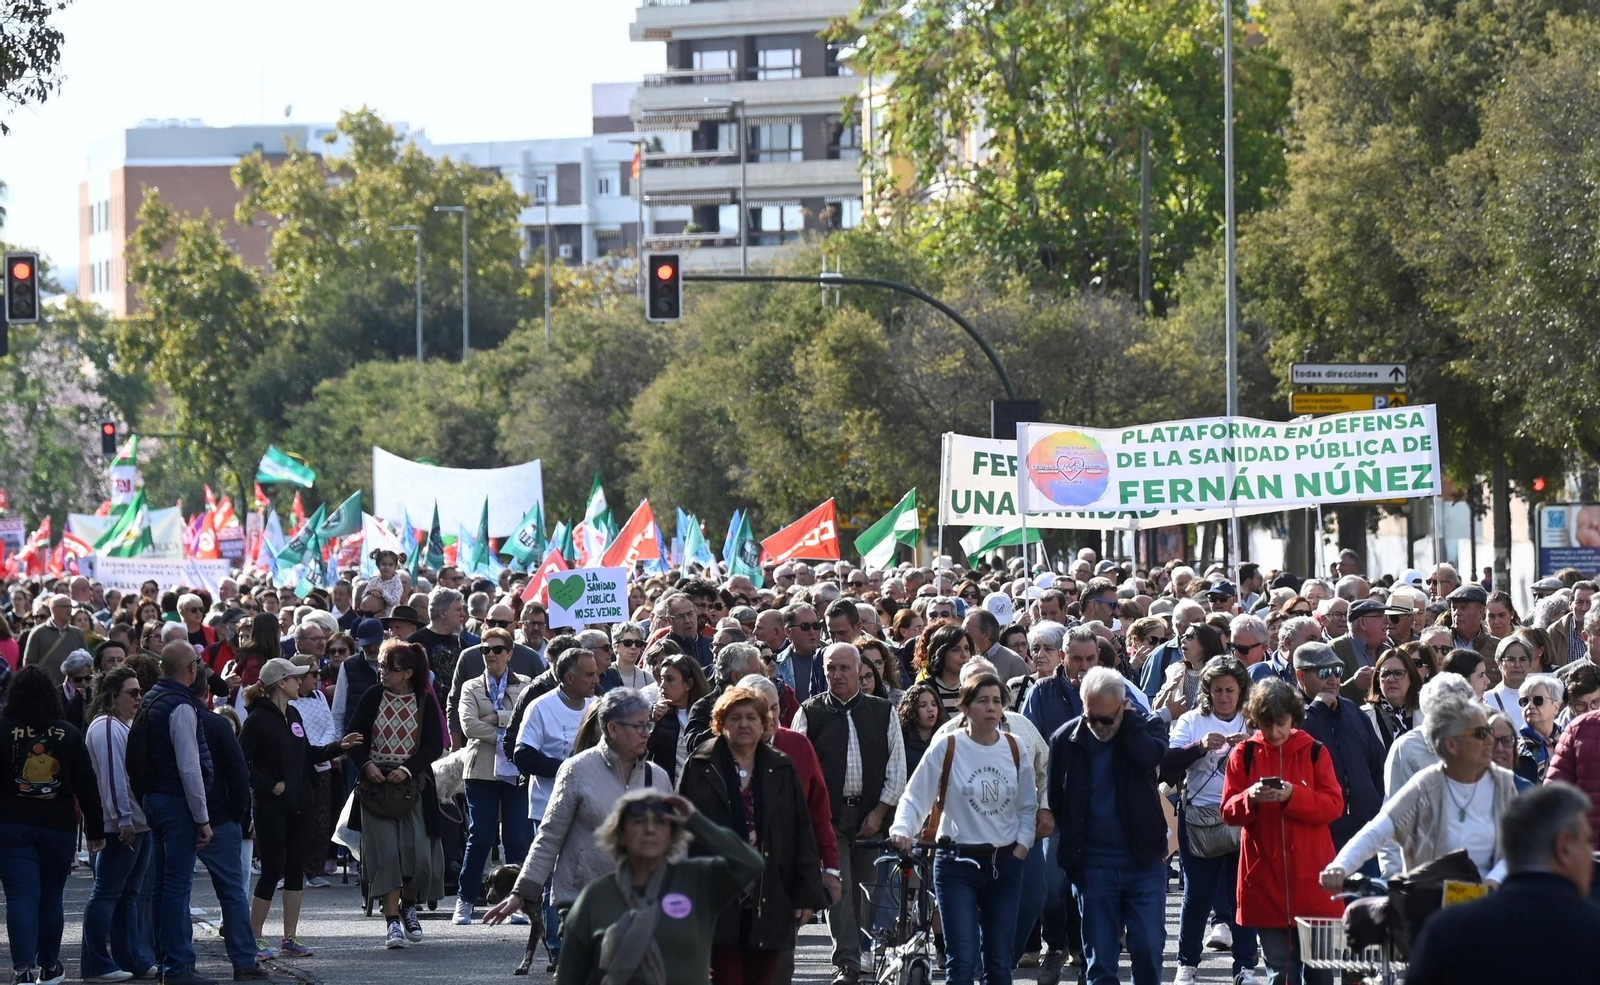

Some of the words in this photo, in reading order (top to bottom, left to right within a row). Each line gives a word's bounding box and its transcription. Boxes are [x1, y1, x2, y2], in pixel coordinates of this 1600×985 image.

[1295, 370, 1322, 378] todas
[1325, 370, 1378, 378] direcciones
[1121, 422, 1277, 445] PLATAFORMA
[1283, 424, 1313, 439] EN
[1318, 411, 1425, 436] DEFENSA
[1116, 451, 1147, 468] DE
[1153, 449, 1183, 467] LA
[1188, 445, 1289, 465] SANIDAD
[1295, 438, 1397, 461] PÚBLICA
[1402, 434, 1432, 453] DE
[1118, 466, 1284, 505] FERNÁN
[1294, 460, 1434, 498] NÚÑEZ
[951, 489, 1016, 516] UNA
[585, 572, 598, 582] LA
[574, 608, 584, 619] NO
[584, 608, 596, 618] SE
[596, 606, 622, 617] VENDE
[981, 779, 1000, 803] N
